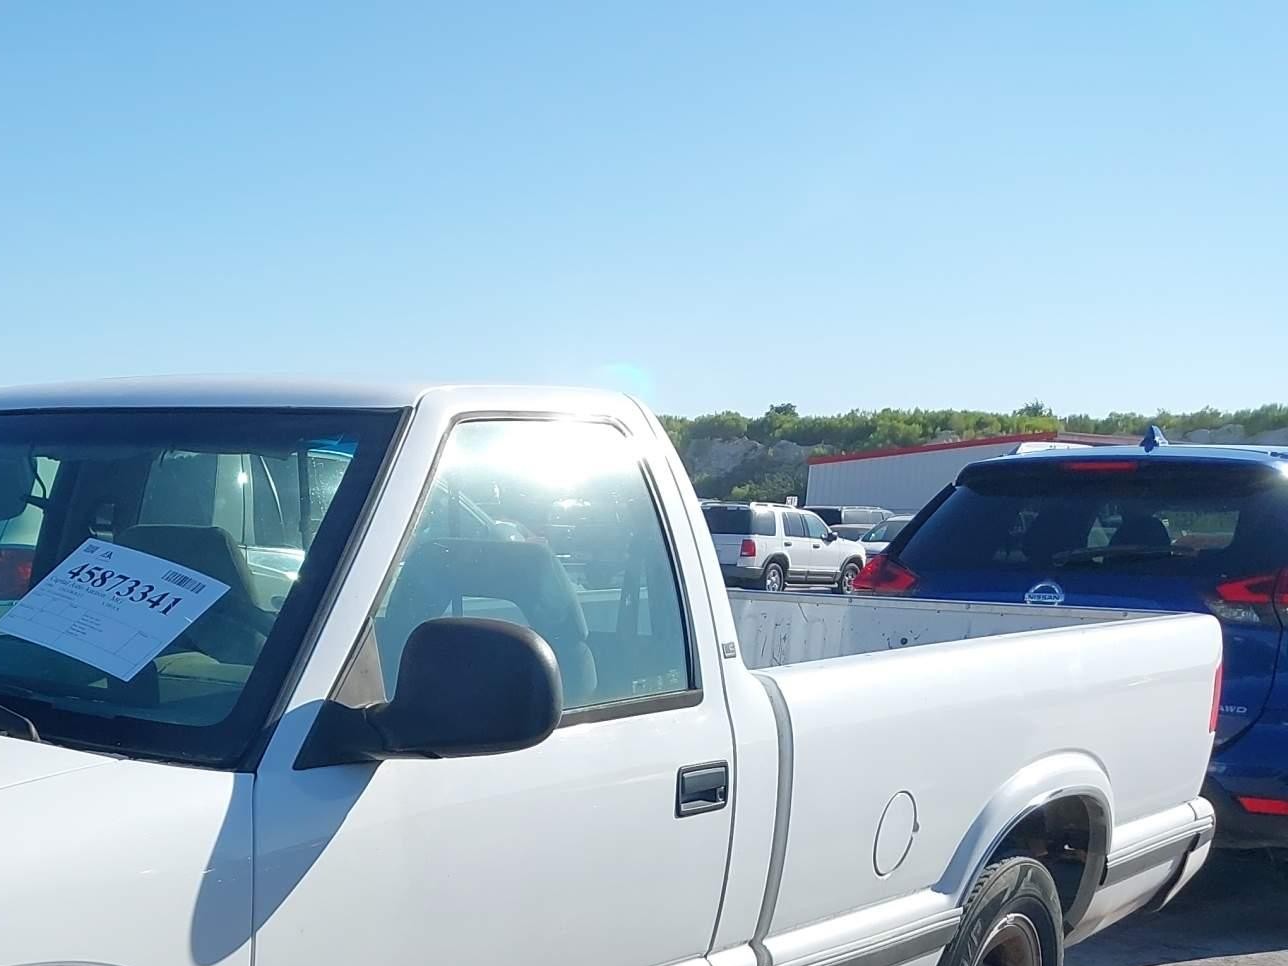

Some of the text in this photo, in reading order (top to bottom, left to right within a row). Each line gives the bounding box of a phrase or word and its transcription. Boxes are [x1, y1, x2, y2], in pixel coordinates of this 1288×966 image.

[67, 562, 183, 616] 45873341
[1027, 593, 1061, 601] NISSAN
[1220, 704, 1248, 713] AWD
